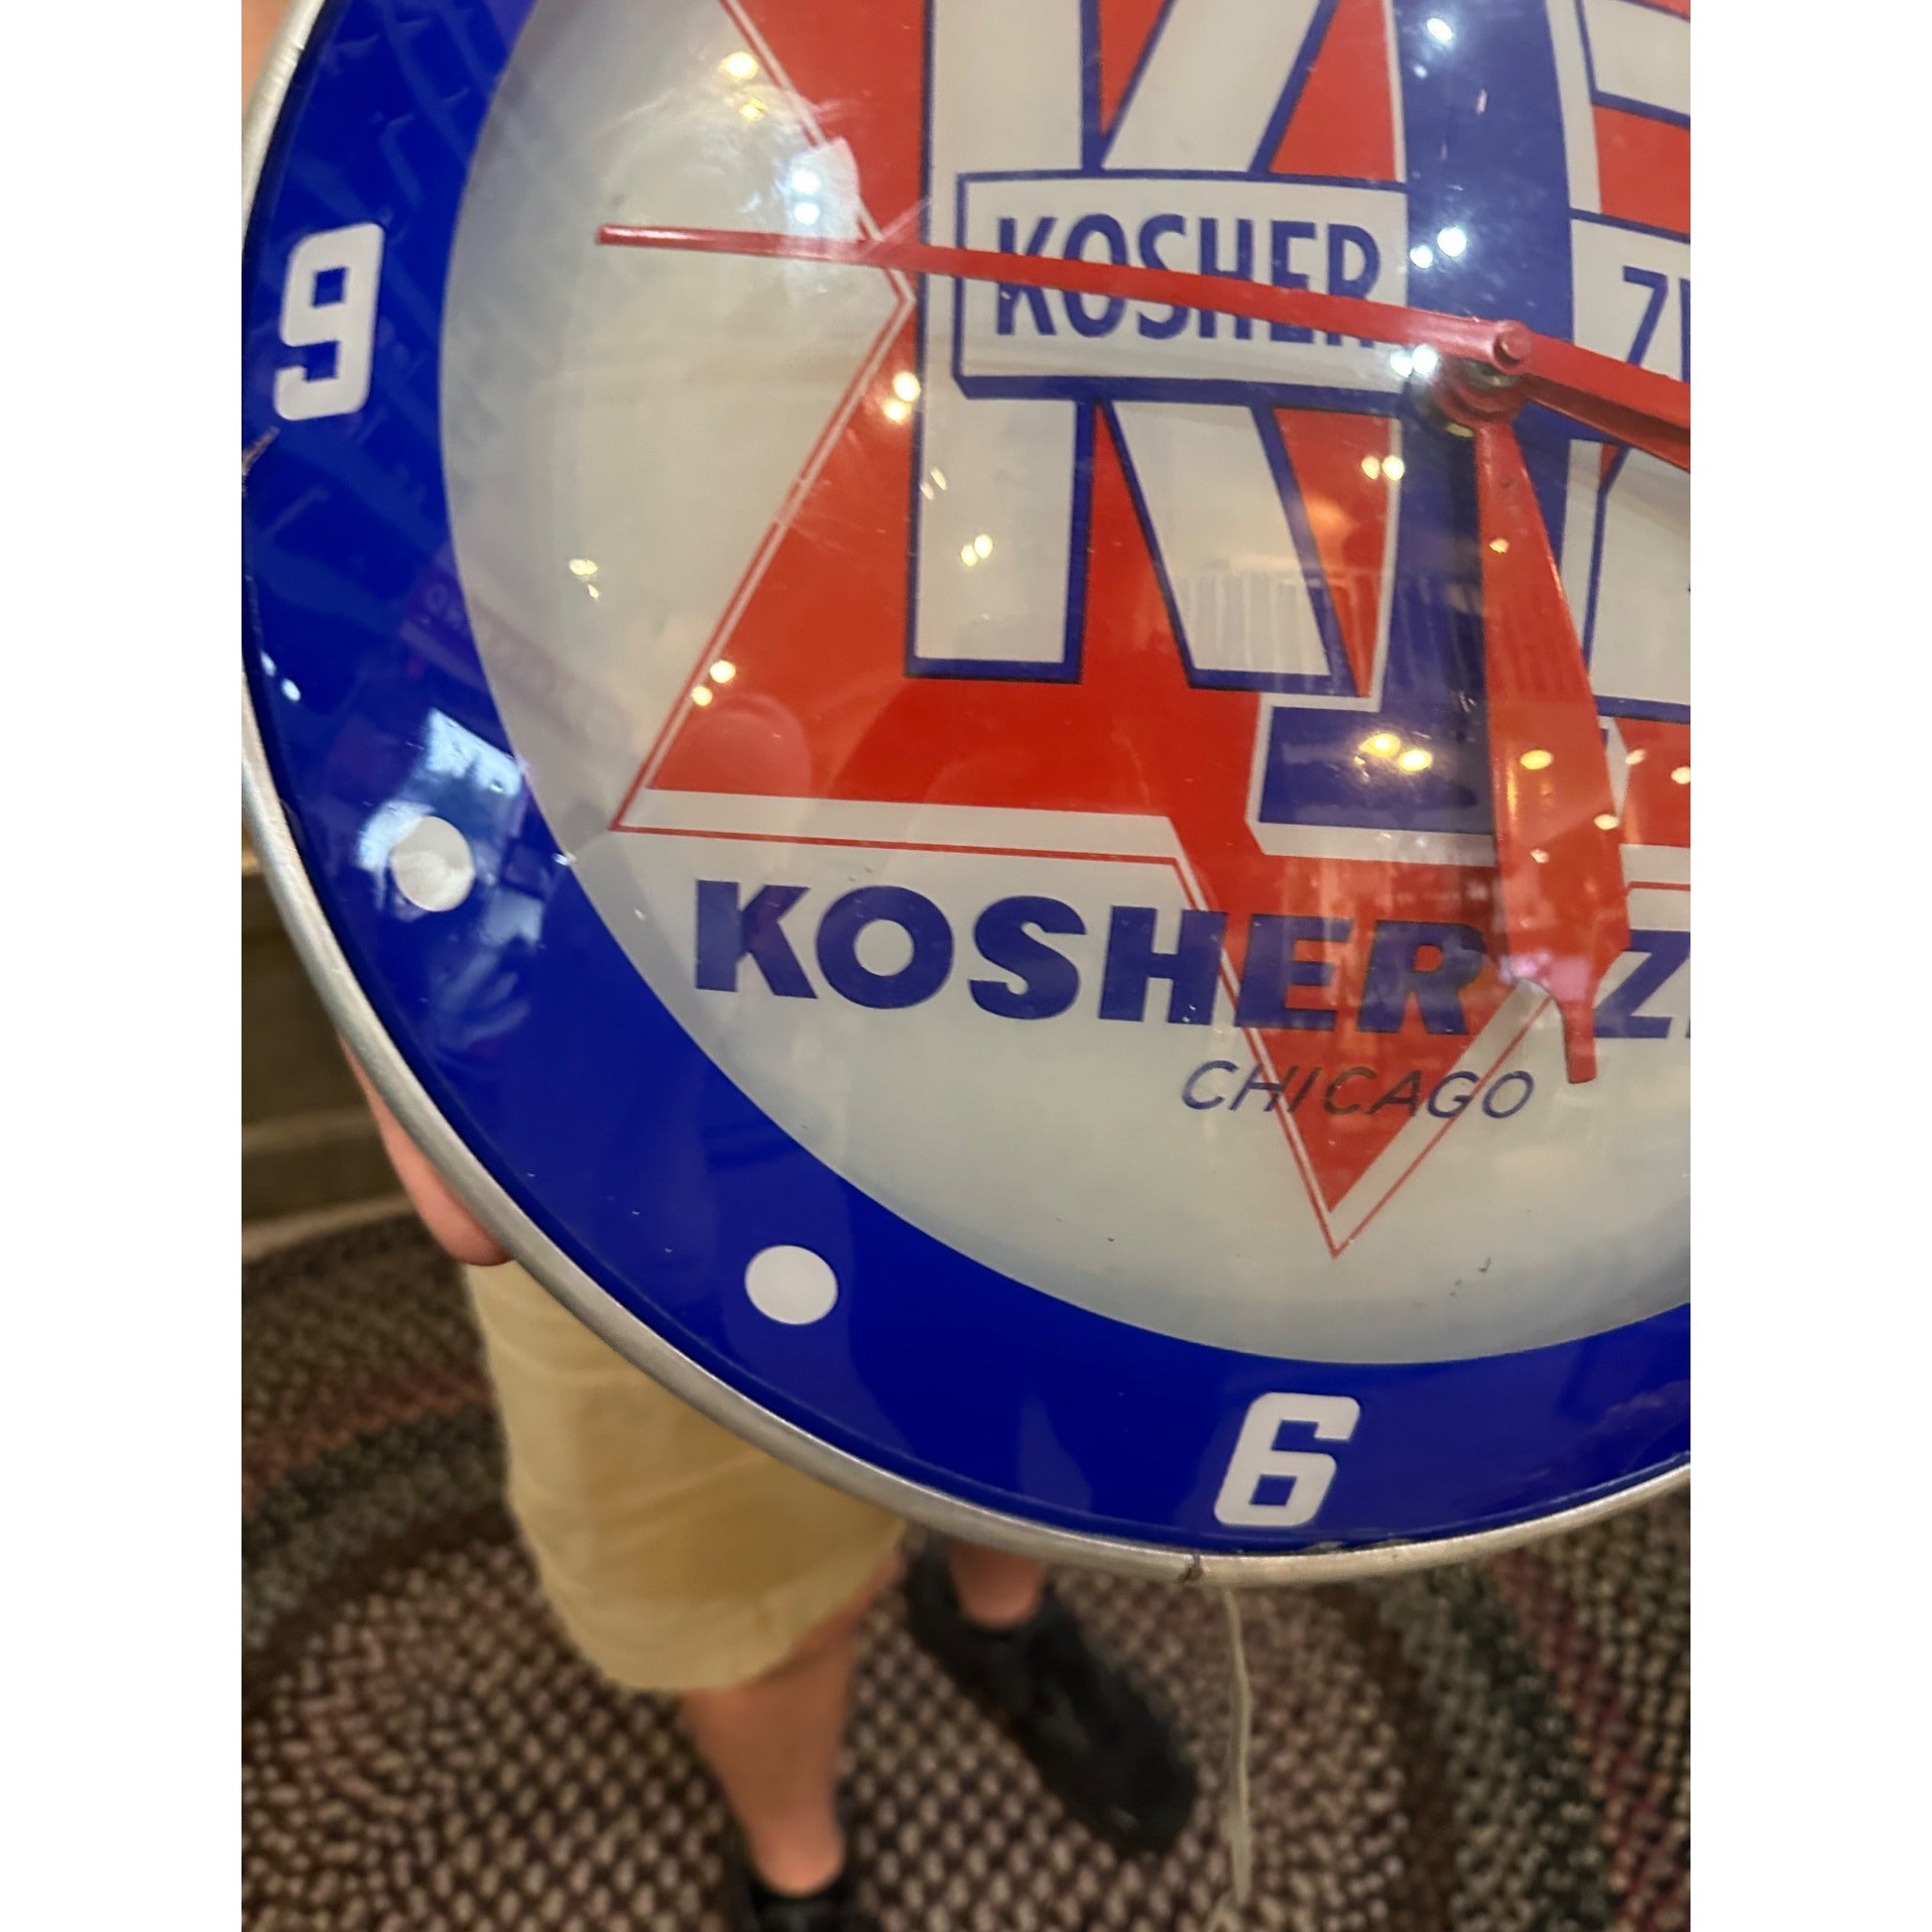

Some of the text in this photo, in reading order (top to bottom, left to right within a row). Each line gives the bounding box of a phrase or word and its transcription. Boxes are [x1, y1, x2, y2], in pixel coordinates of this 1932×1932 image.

[273, 222, 384, 421] 9
[996, 213, 1381, 349] KOSHER
[695, 879, 1690, 1039] KOSHER Z
[1180, 1059, 1535, 1120] CHICAGO
[1213, 1391, 1361, 1527] 6
